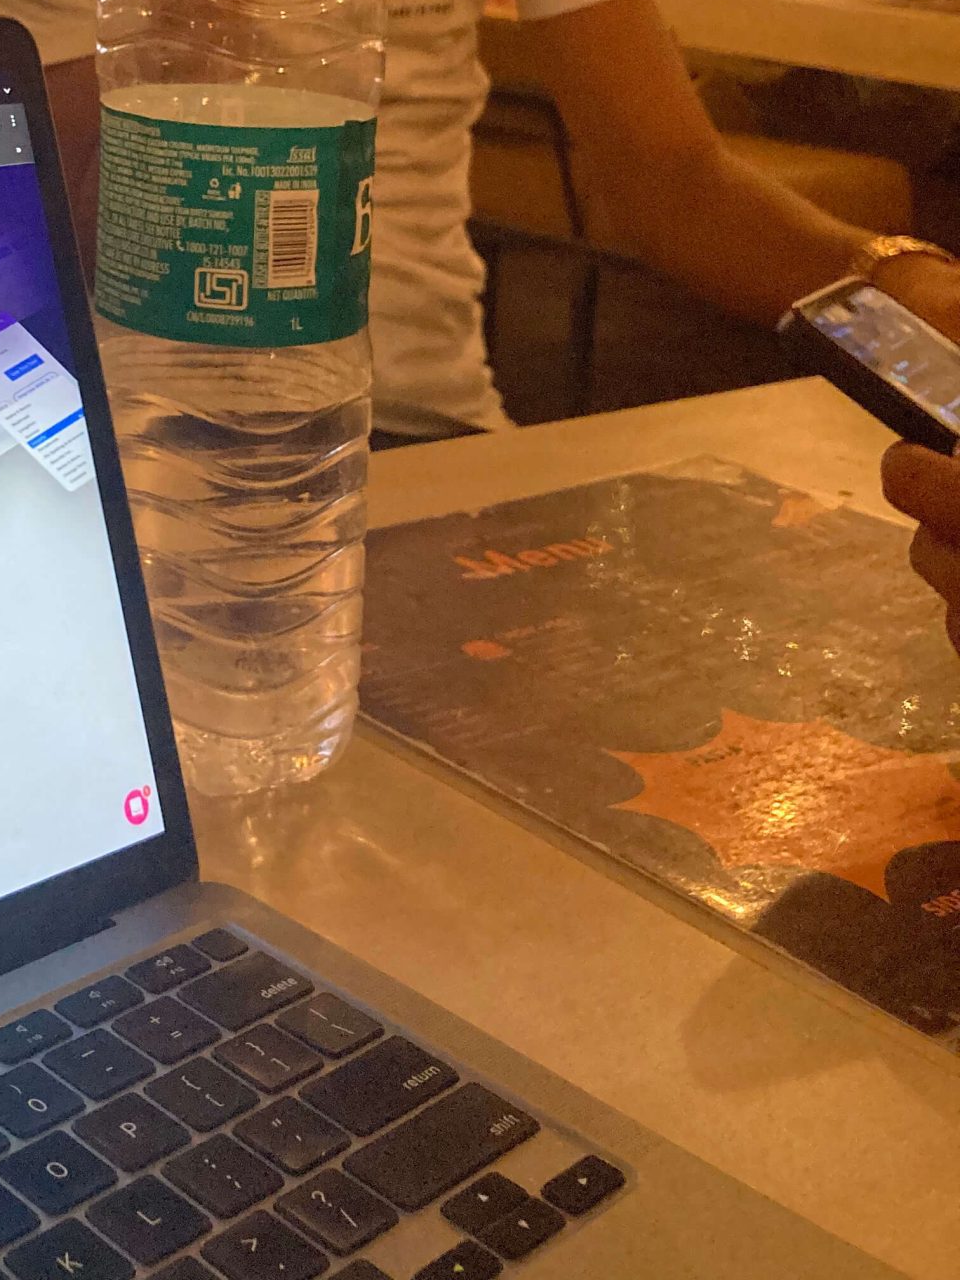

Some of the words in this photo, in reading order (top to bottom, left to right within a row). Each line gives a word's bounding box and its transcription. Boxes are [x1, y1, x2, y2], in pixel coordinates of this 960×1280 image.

[286, 145, 317, 163] fssai
[290, 316, 304, 331] 1L
[455, 536, 612, 580] Menu
[259, 977, 298, 999] delete
[401, 1065, 441, 1090] return
[120, 1122, 137, 1138] P
[489, 1113, 517, 1137] shift
[45, 1162, 68, 1178] O
[136, 1211, 160, 1225] L
[56, 1251, 83, 1274] K
